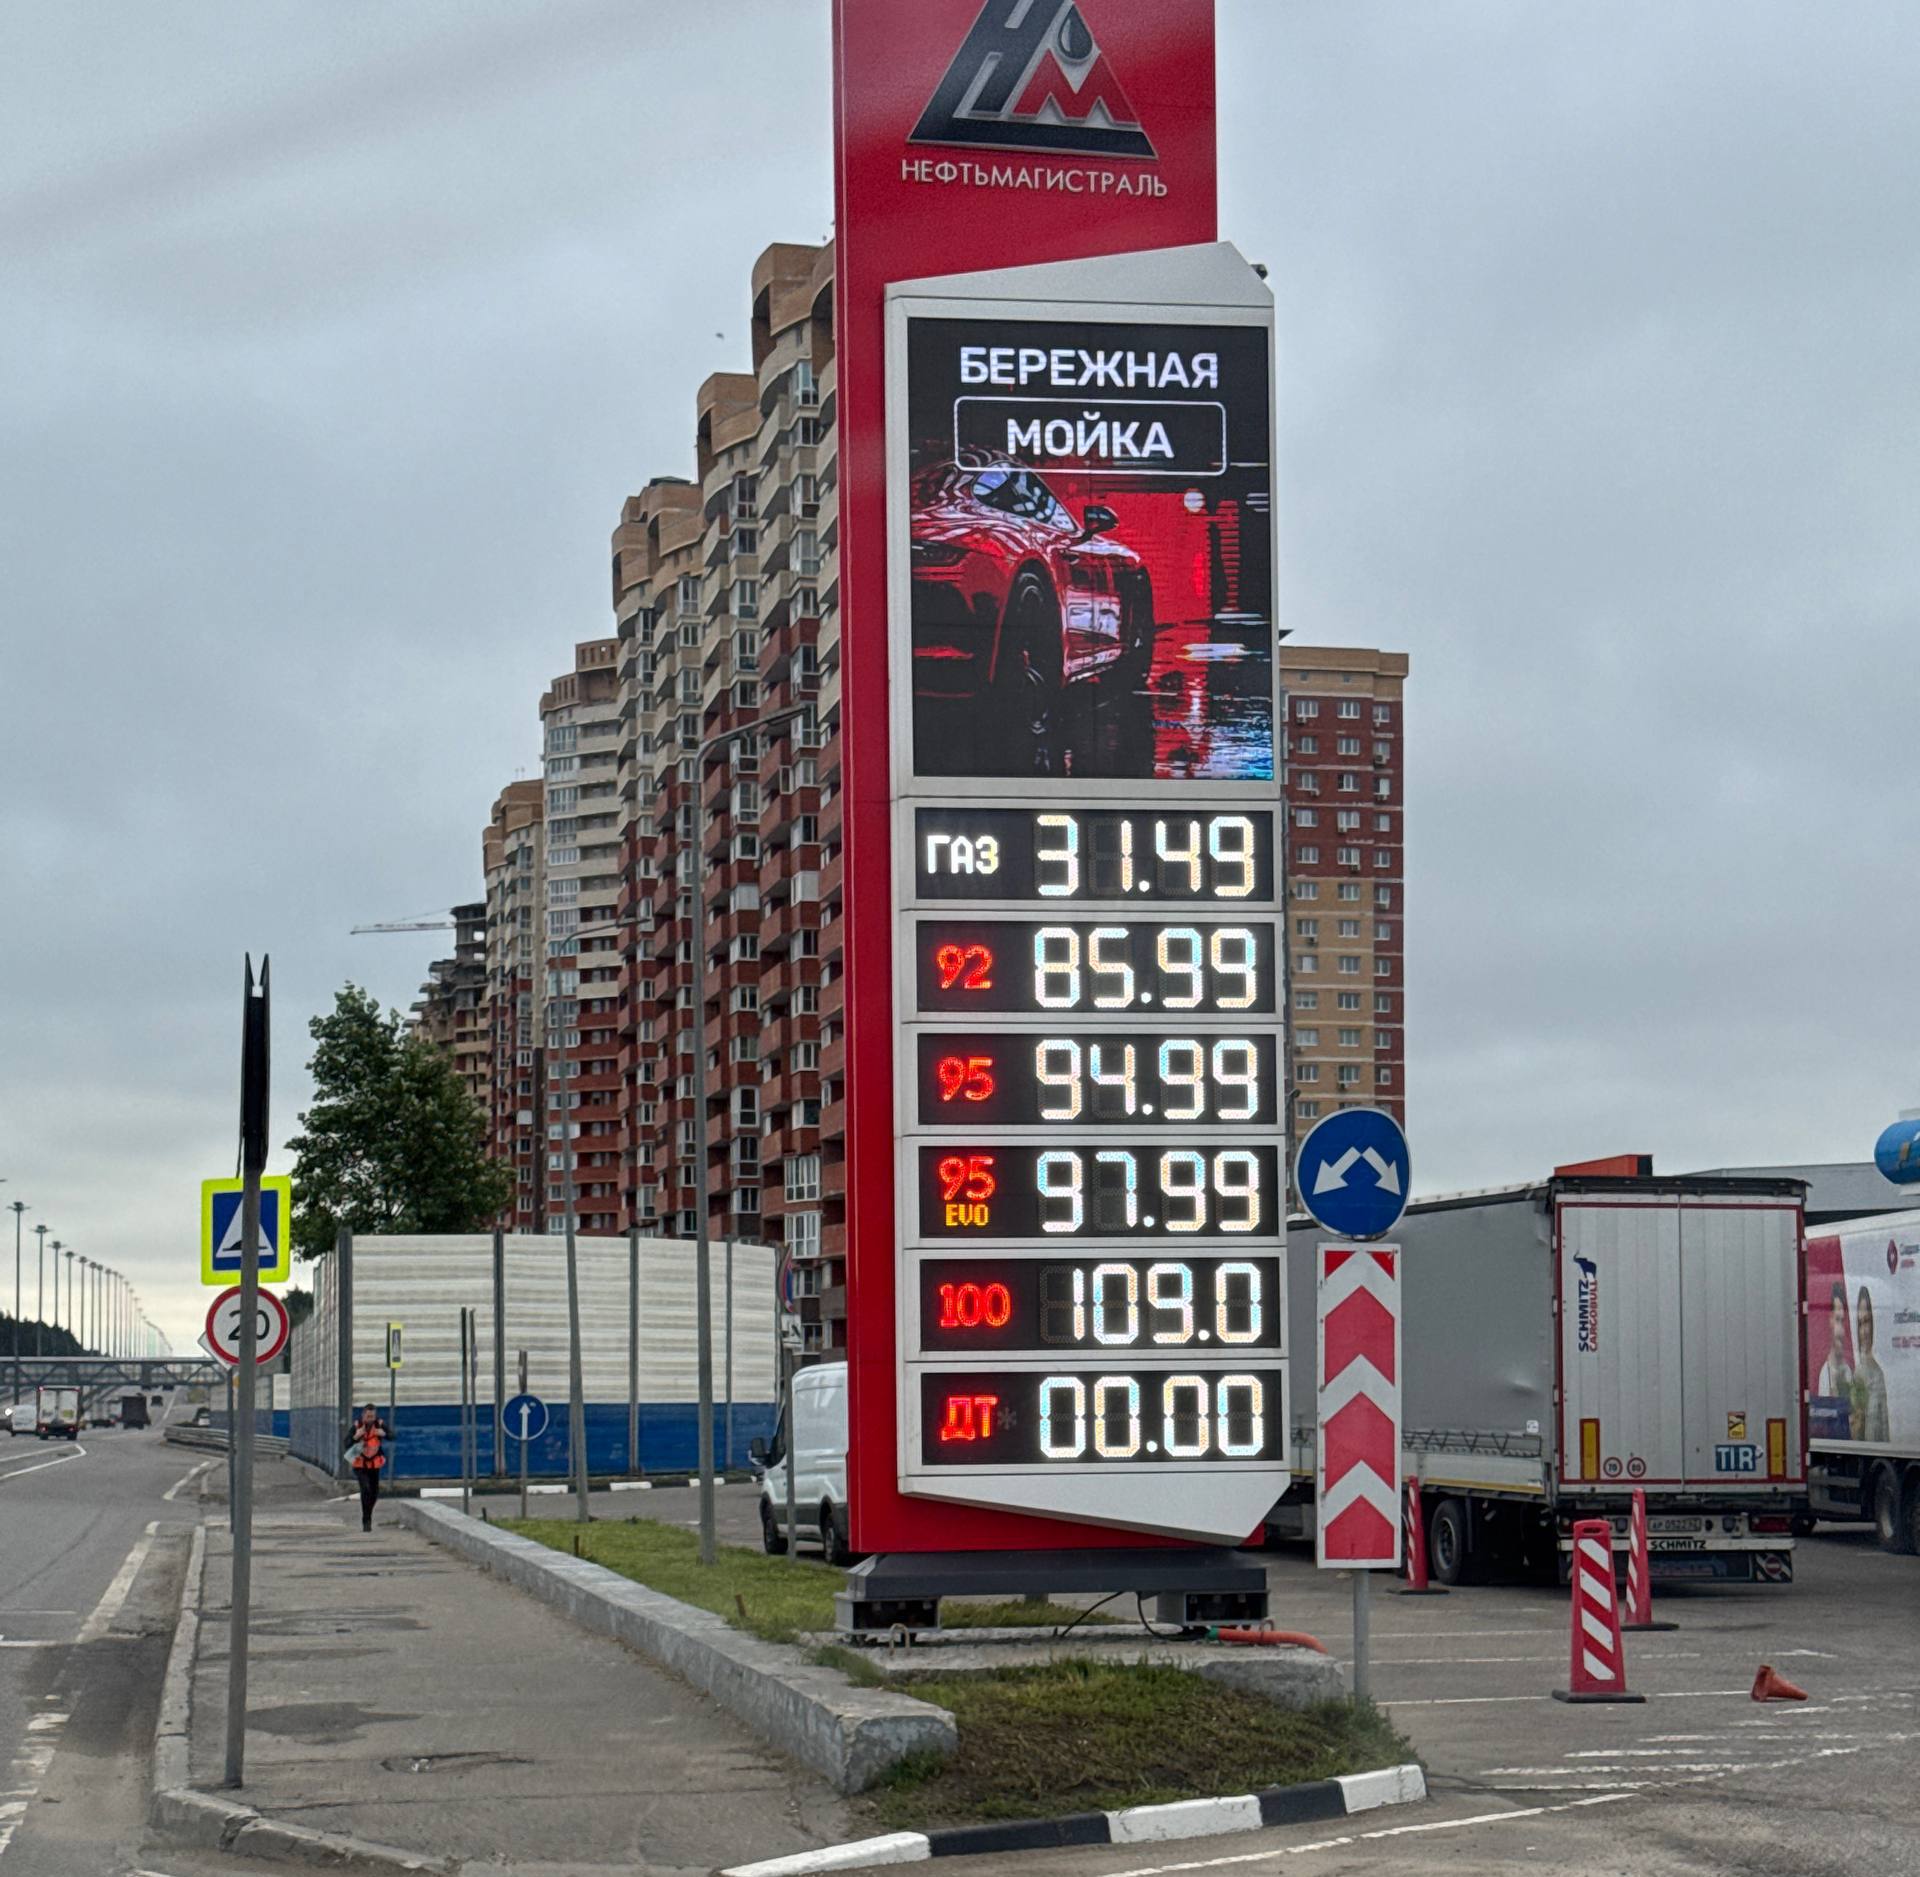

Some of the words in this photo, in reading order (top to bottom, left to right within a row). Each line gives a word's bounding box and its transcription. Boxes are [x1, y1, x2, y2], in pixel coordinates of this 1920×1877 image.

[901, 159, 1168, 198] НЕФТЬМАГИСТРАЛЬ
[960, 346, 1219, 389] БЕРЕЖНАЯ
[1006, 411, 1175, 459] МОЙКА
[926, 835, 999, 874] ГАЗ
[1037, 815, 1255, 897] 31.49
[936, 944, 993, 990] 92
[1034, 927, 1257, 1008] 85.99
[937, 1056, 995, 1101] 95
[1035, 1039, 1258, 1120] 94.99
[939, 1156, 996, 1200] 95
[1037, 1151, 1260, 1232] 97.99
[945, 1204, 990, 1227] EVO
[227, 1309, 270, 1341] 20
[939, 1283, 1012, 1328] 100
[1071, 1263, 1262, 1345] 109.0
[1578, 1279, 1589, 1353] SCHMITZ
[1589, 1280, 1598, 1353] CARGOBULL
[941, 1396, 998, 1441] ДТ
[1039, 1375, 1264, 1458] 00.00
[1717, 1447, 1754, 1470] TIR
[1651, 1540, 1706, 1550] SCHMITZ
